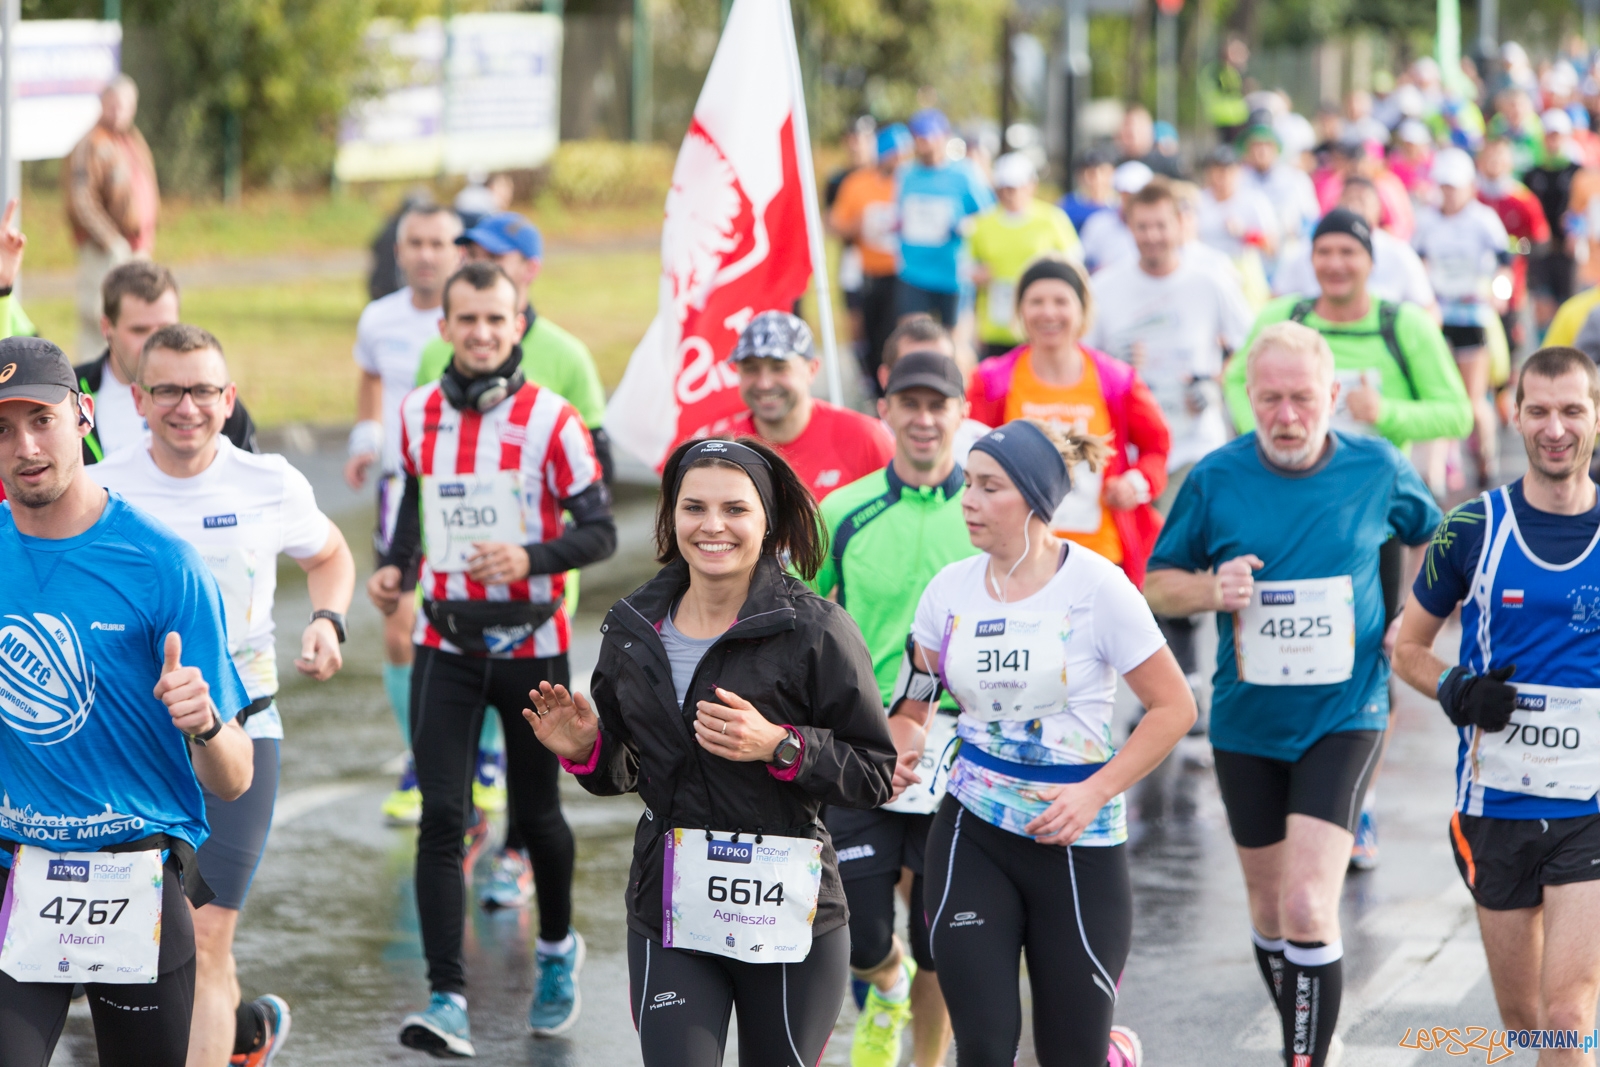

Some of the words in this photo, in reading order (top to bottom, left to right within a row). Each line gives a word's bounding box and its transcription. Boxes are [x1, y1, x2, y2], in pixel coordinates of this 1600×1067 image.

[442, 506, 497, 528] 1430
[1260, 615, 1332, 638] 4825
[54, 628, 67, 645] KSK
[0, 632, 52, 687] NOTEĆ
[976, 649, 1030, 673] 3141
[979, 680, 1028, 690] Dominika
[1505, 722, 1580, 750] 7000
[22, 826, 71, 841] MOJE
[77, 816, 145, 840] MIASTO
[755, 854, 789, 863] maraton
[93, 871, 131, 880] maraton
[707, 875, 784, 907] 6614
[39, 896, 130, 926] 4767
[713, 909, 776, 926] Agnieszka
[59, 933, 105, 945] Marcin
[749, 944, 764, 952] 4F
[87, 963, 105, 972] 4F
[649, 998, 686, 1011] Kalenji
